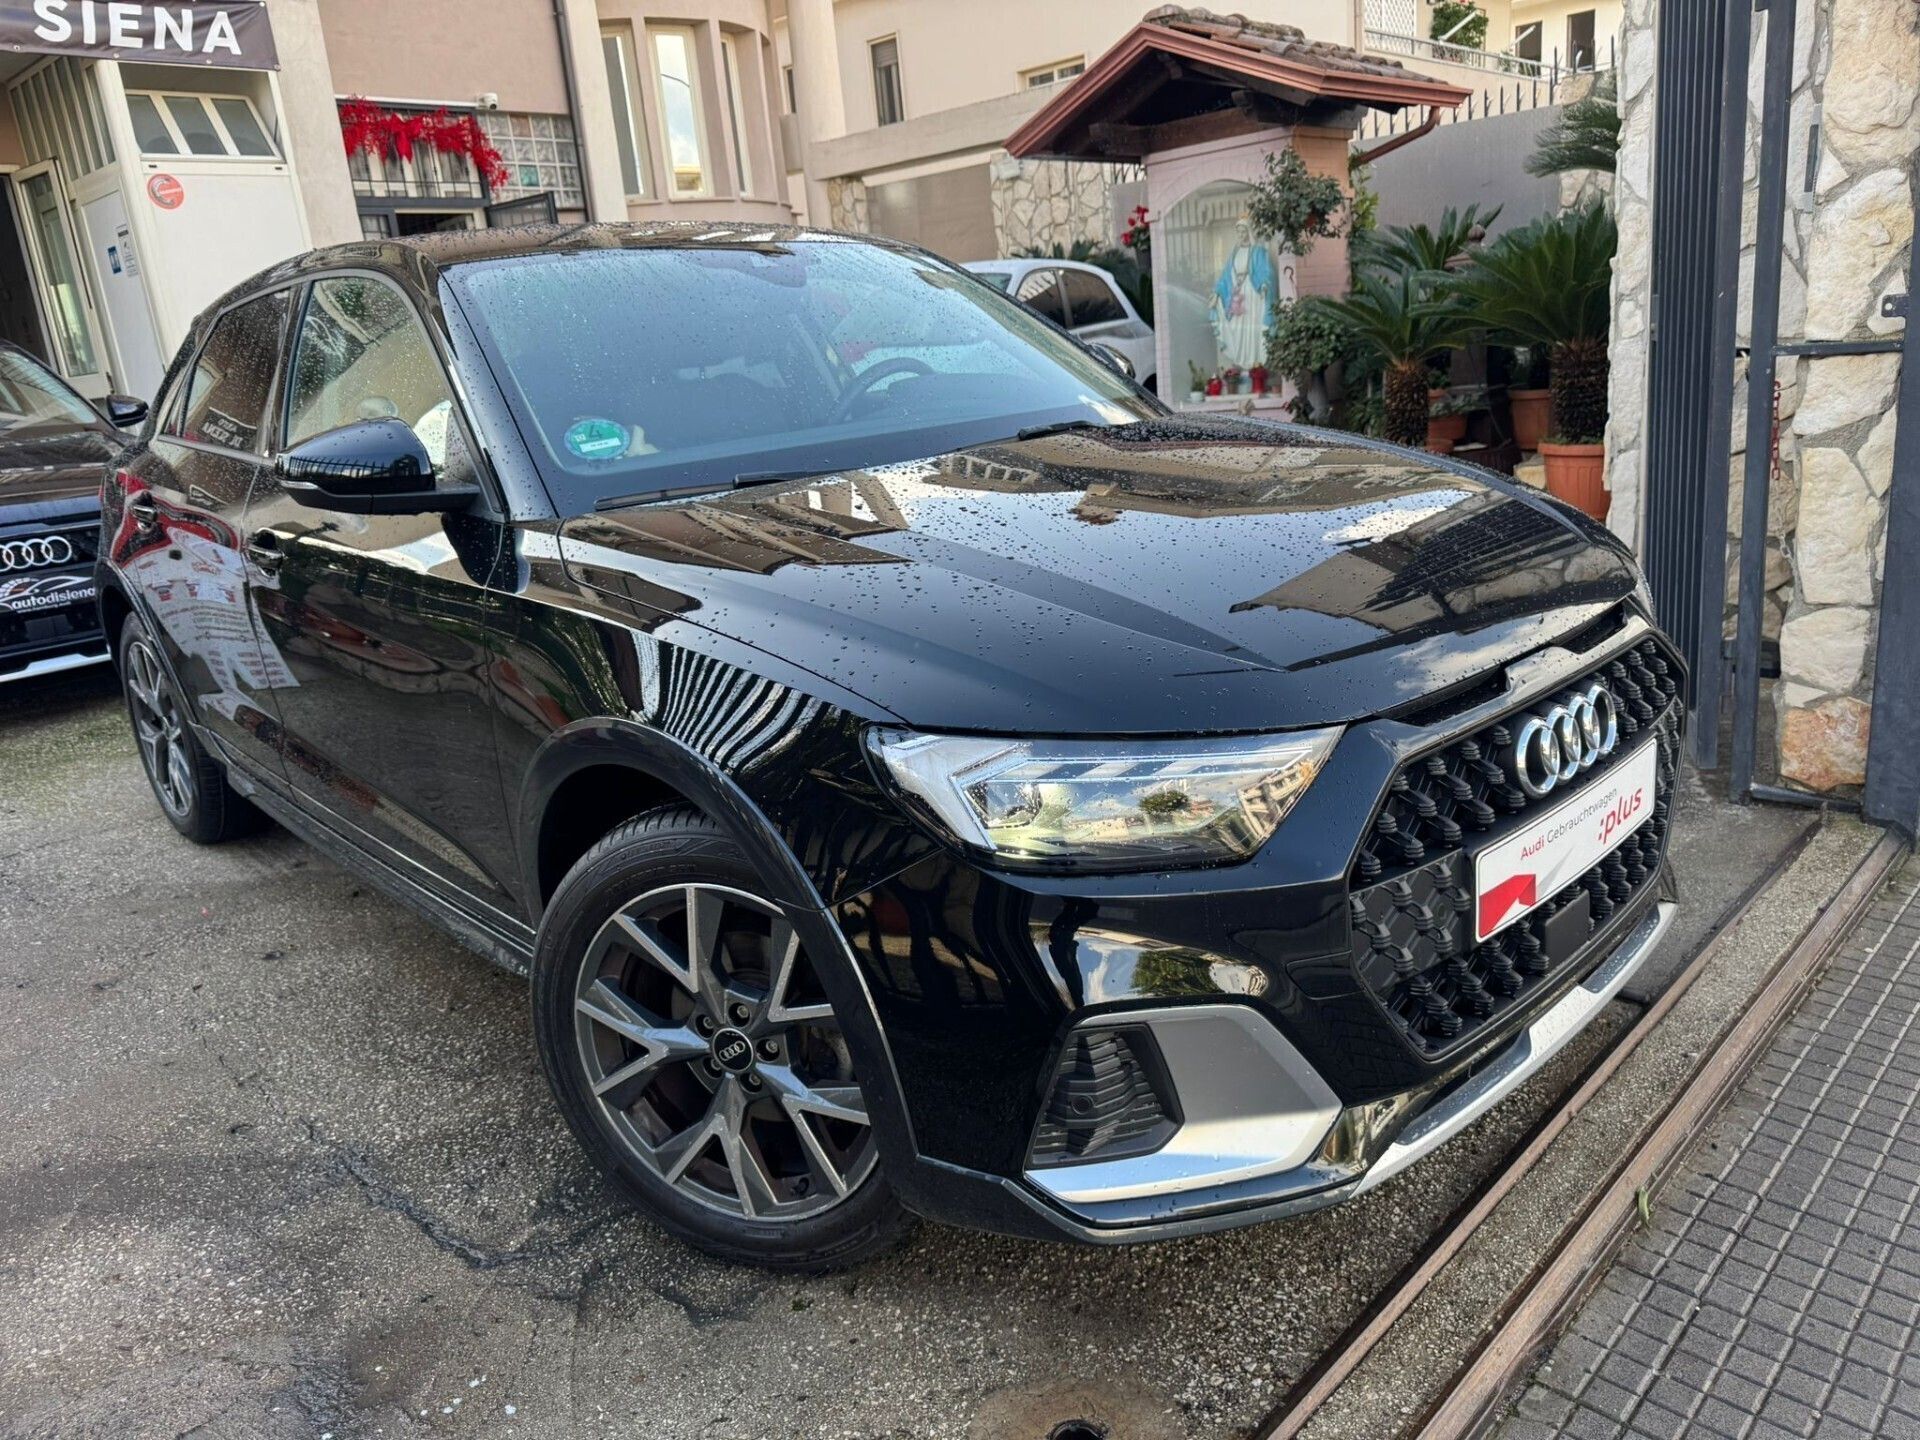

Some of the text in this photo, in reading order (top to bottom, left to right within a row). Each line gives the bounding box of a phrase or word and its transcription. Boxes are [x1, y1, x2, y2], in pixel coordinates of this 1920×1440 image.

[34, 0, 242, 55] SIENA
[1520, 788, 1617, 861] Audi Gebrauchtwagen
